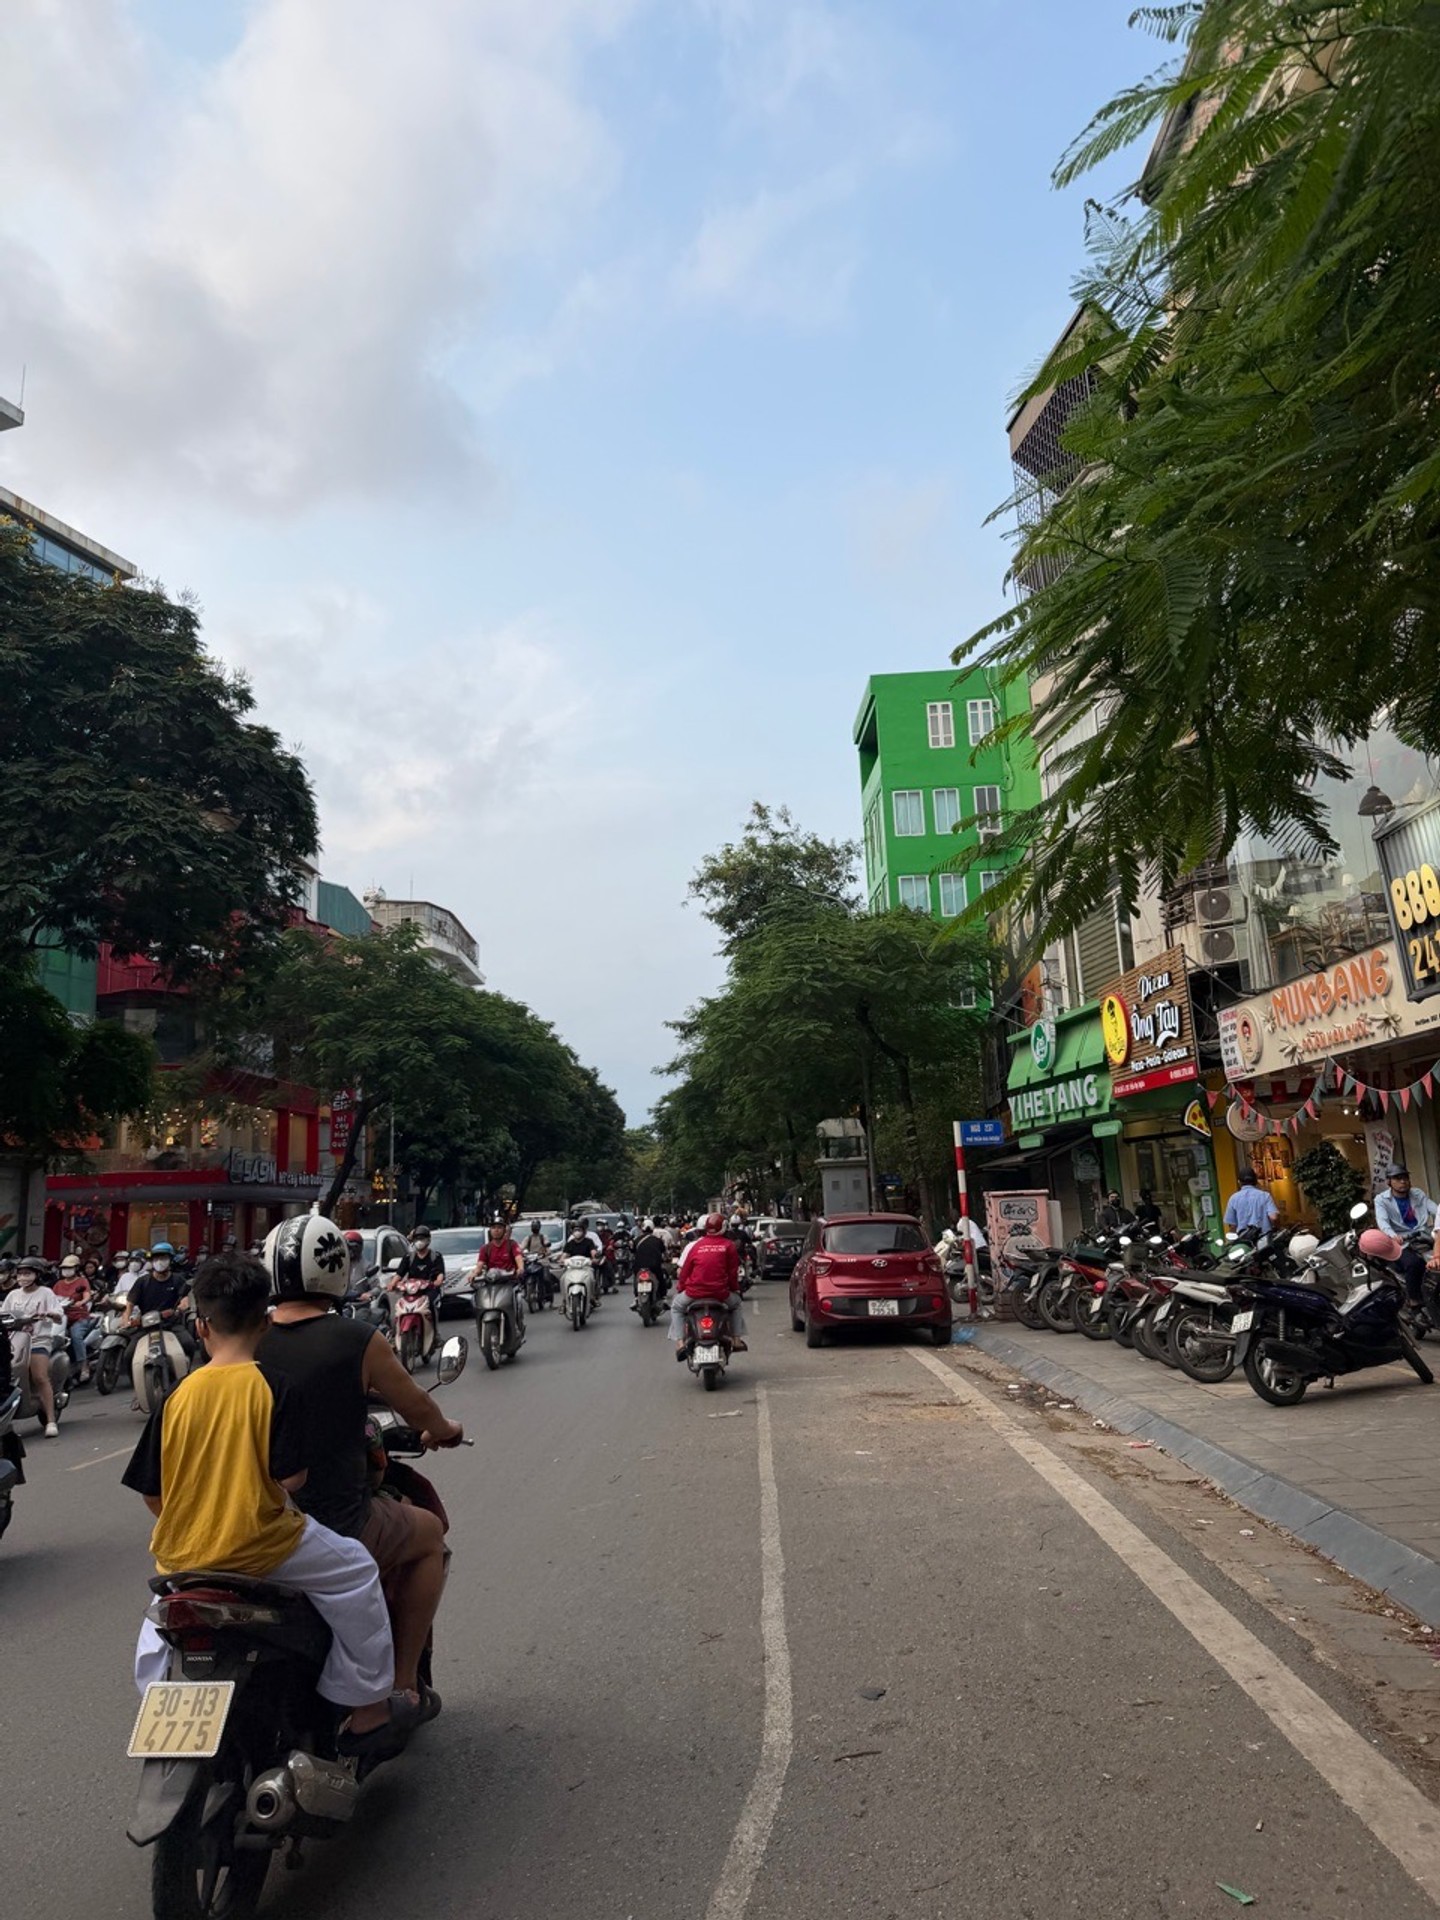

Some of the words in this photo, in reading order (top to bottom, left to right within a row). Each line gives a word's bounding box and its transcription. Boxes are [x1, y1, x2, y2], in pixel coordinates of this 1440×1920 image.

[1138, 972, 1171, 1001] Pizza
[1271, 949, 1389, 1029] MUKBANG
[1131, 1003, 1155, 1044] Ông
[1155, 1000, 1179, 1048] Tây
[153, 1687, 220, 1718] 30-H3
[144, 1720, 212, 1751] 4775
